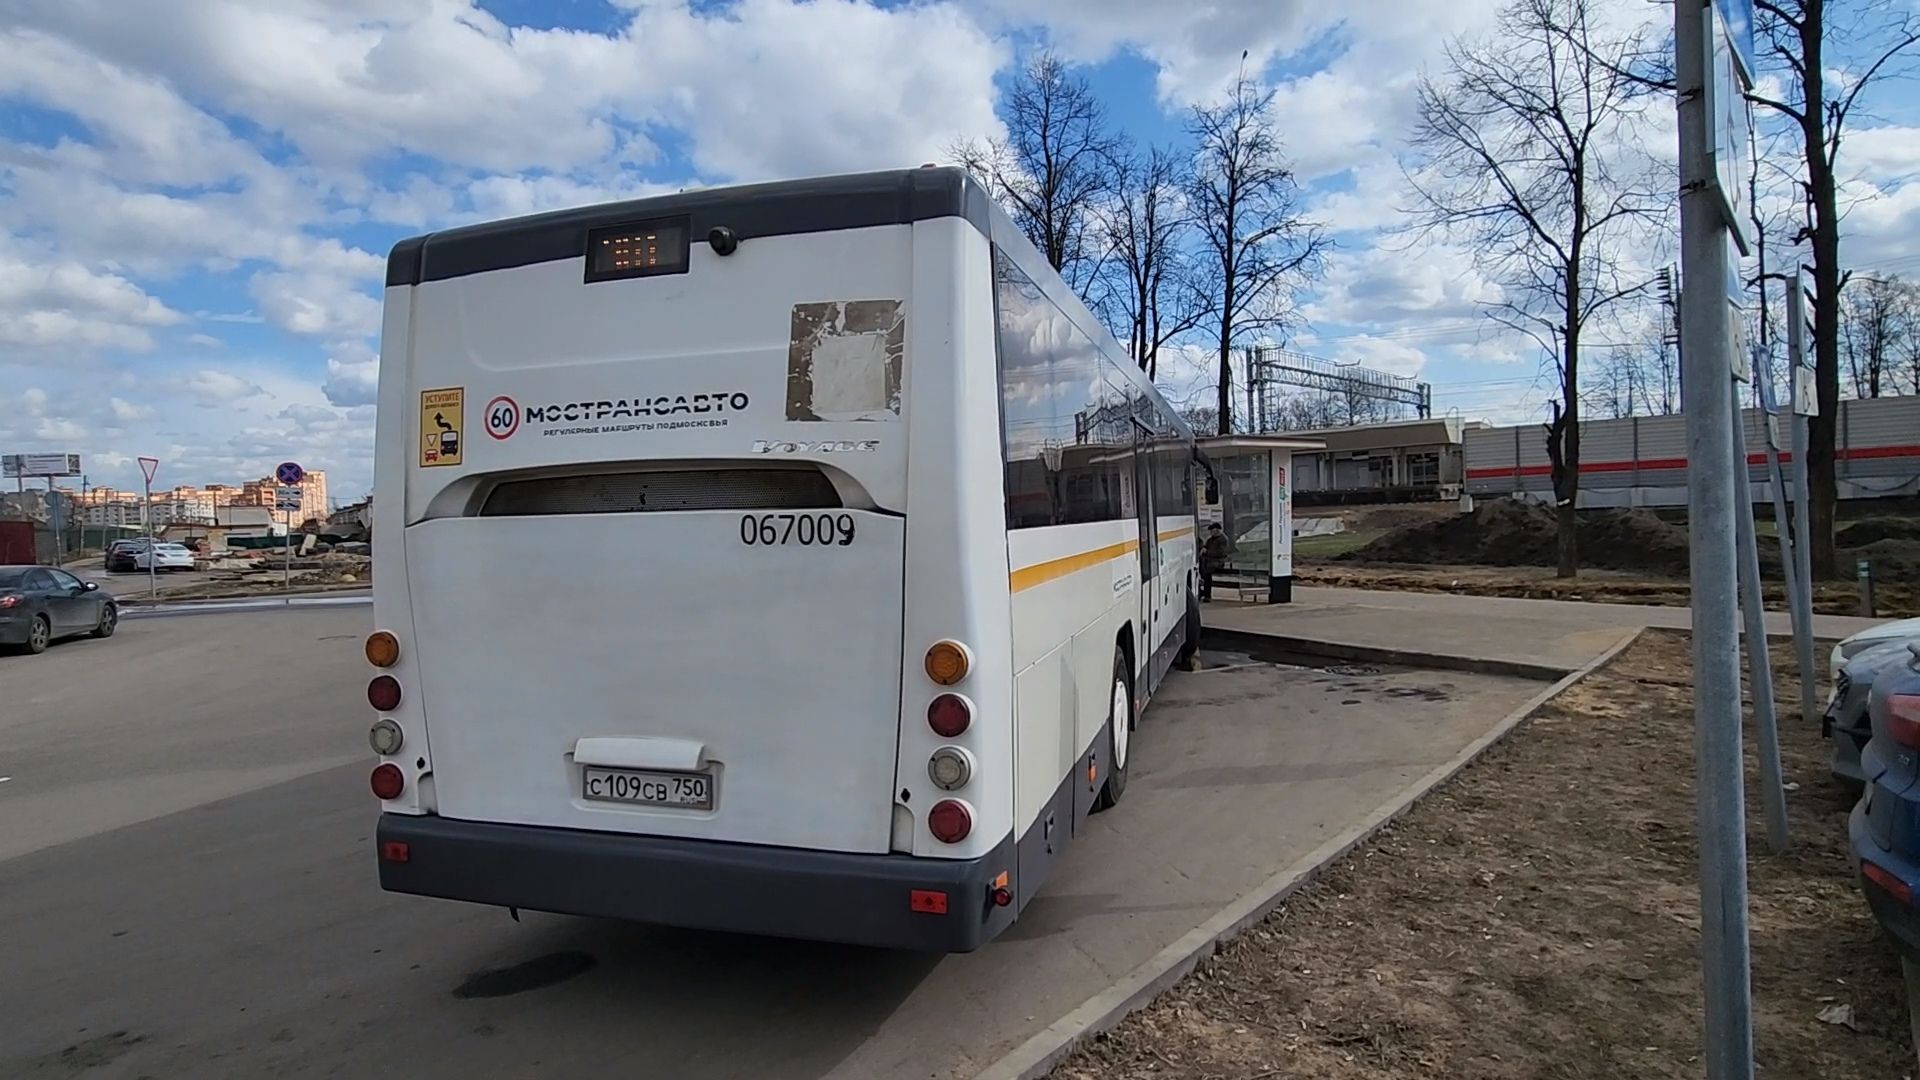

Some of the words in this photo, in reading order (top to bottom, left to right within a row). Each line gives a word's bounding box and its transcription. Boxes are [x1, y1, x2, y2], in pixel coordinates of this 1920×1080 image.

[491, 407, 513, 428] 60
[526, 392, 749, 423] МОСТРАНСАВТО
[543, 427, 600, 437] РЕГУЛЯРНЫЕ
[601, 423, 655, 433] МАРШРУТЫ
[741, 514, 855, 546] 067009
